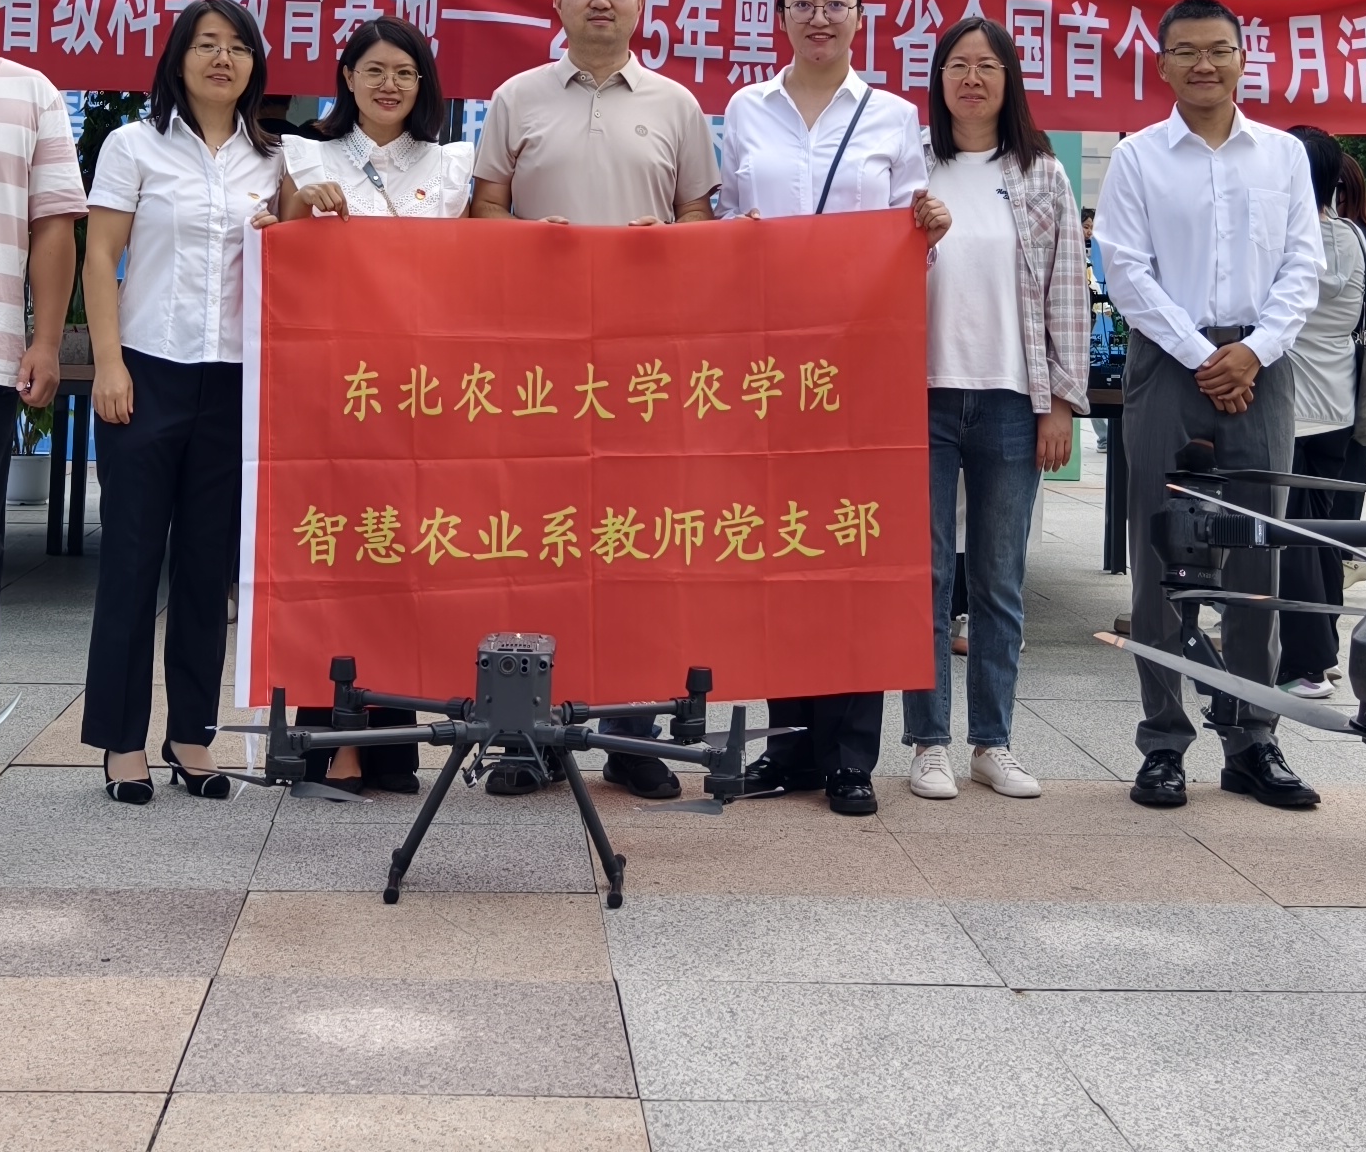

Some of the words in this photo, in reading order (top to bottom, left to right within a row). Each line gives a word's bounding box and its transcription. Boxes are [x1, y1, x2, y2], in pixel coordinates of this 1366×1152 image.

[342, 355, 841, 423] 东北农业大学农学院
[292, 497, 883, 568] 智慧农业系教师党支部
